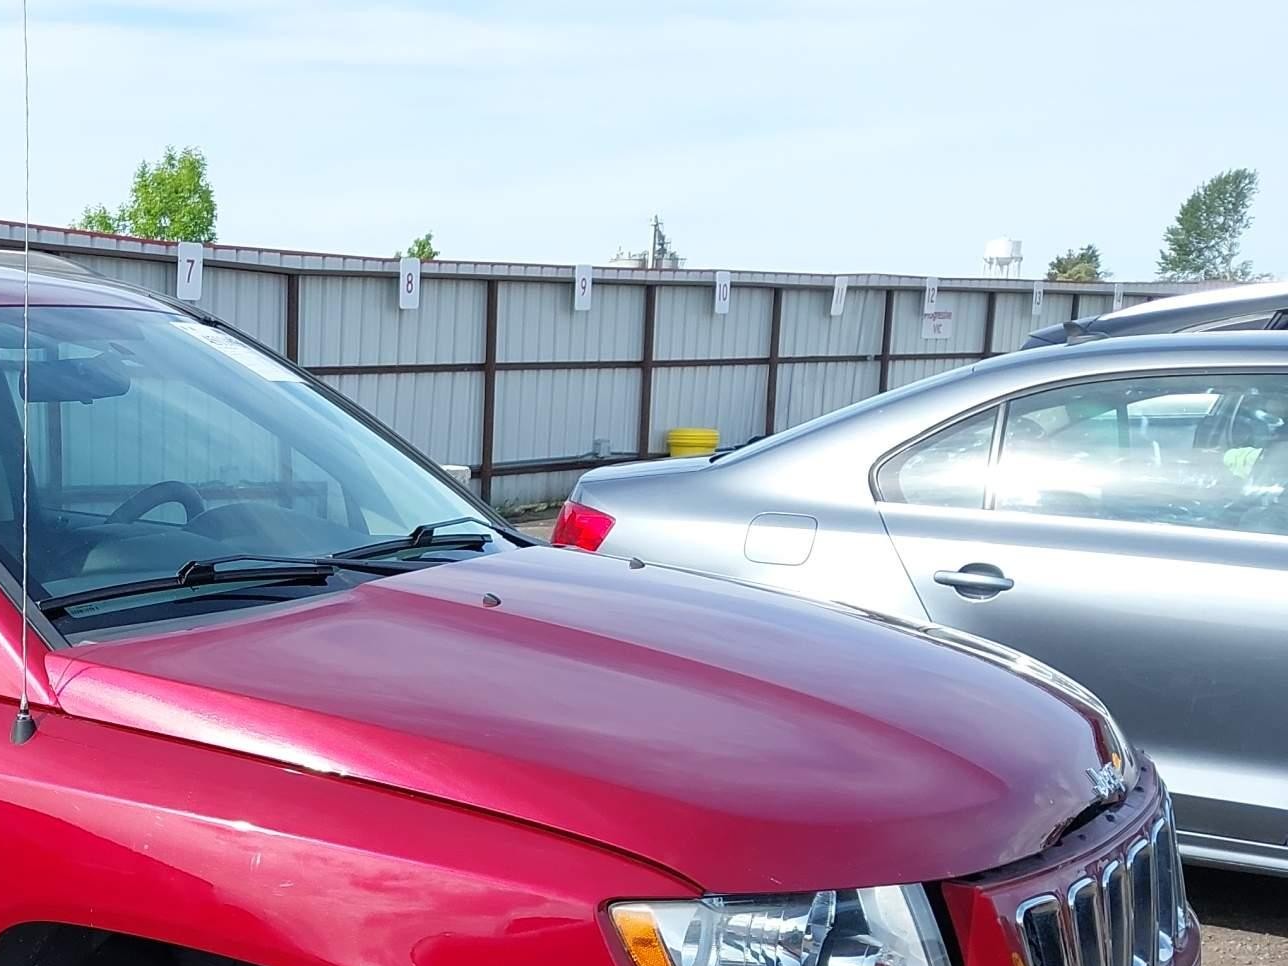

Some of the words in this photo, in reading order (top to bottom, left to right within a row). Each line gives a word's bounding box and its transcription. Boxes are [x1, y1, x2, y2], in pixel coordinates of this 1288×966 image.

[186, 260, 195, 283] 7
[406, 272, 414, 294] 8
[580, 277, 587, 297] 9
[718, 283, 728, 301] 10
[927, 287, 936, 303] 12
[1034, 291, 1042, 305] 13
